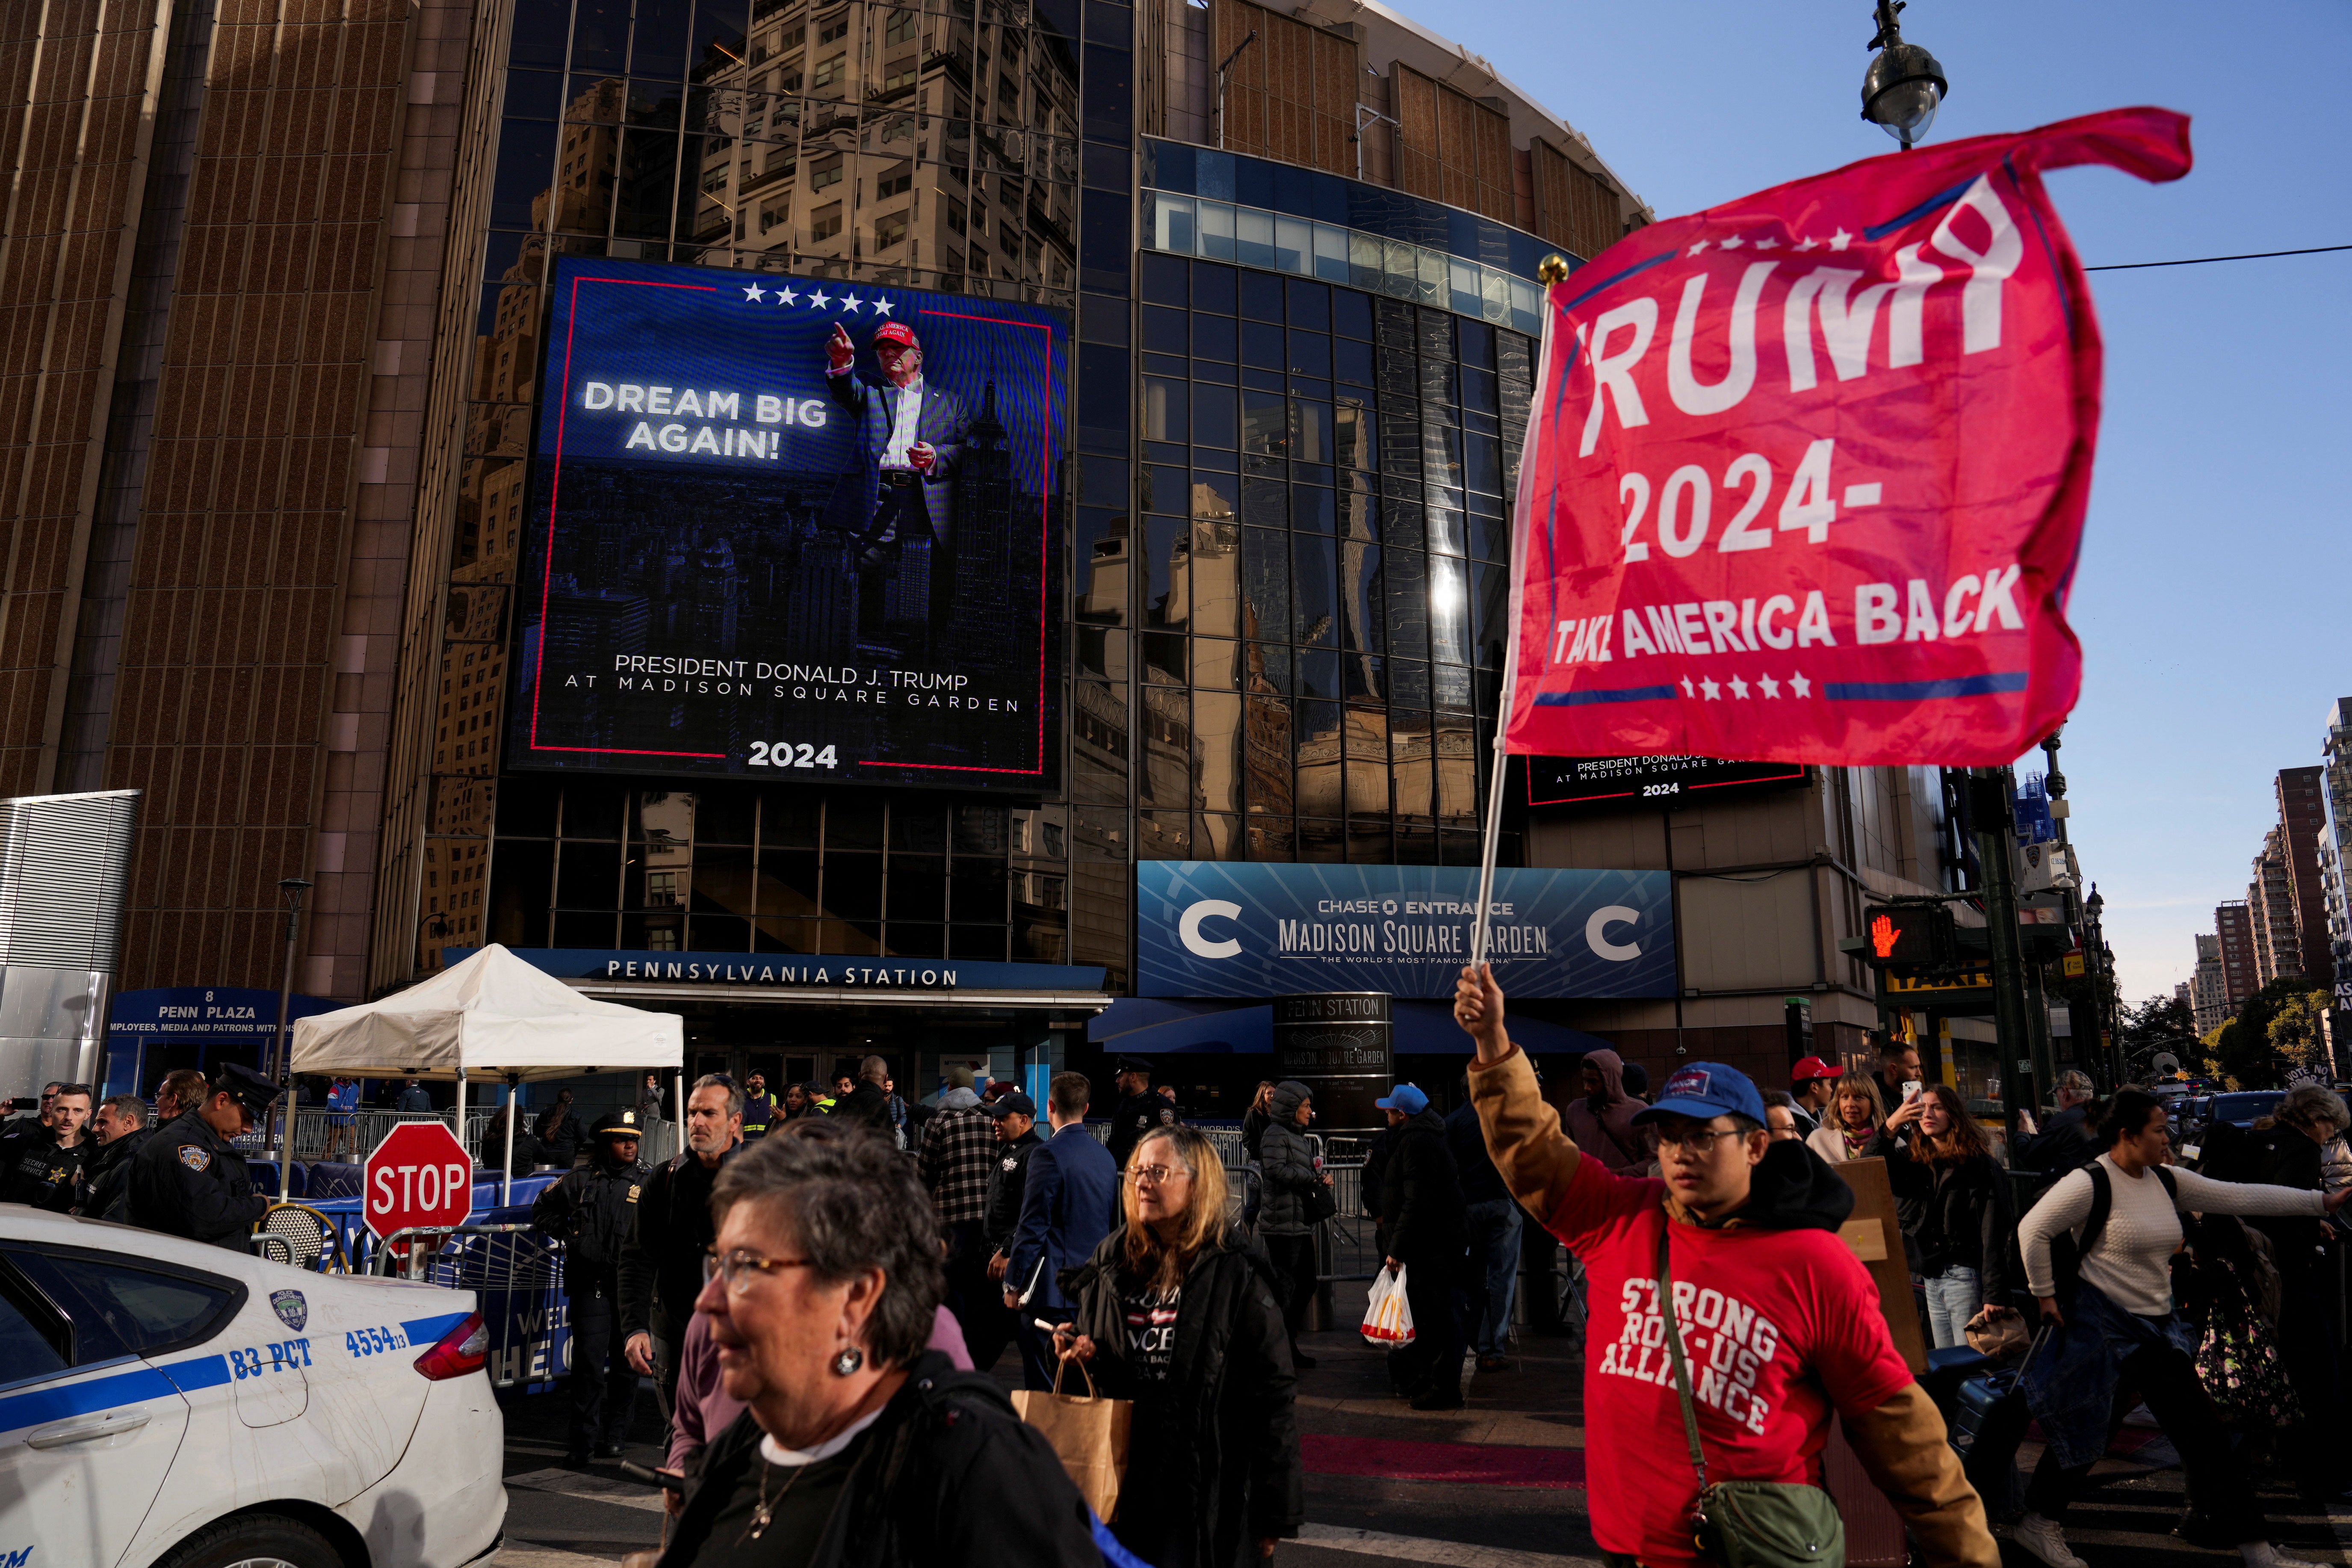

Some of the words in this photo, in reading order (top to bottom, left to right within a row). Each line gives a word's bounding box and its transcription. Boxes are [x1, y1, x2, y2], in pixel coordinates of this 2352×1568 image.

[1576, 172, 2022, 458] RUMP
[885, 324, 908, 332] AMERICA
[584, 381, 740, 420] DREAM
[757, 395, 827, 428] BIG
[625, 422, 780, 460] AGAIN!
[1625, 589, 1837, 659] AMERICA
[1855, 564, 2025, 644] BACK
[615, 655, 748, 678] PRESIDENT
[756, 662, 858, 684] DONALD
[866, 669, 882, 686] J.
[889, 670, 968, 691] TRUMP
[565, 674, 597, 688] AT
[620, 678, 752, 696] MADISON
[774, 685, 887, 704] SQUARE
[908, 694, 1018, 712] GARDEN
[748, 741, 838, 769] 2024
[1577, 757, 1638, 772] PRESIDENT
[1557, 775, 1571, 783] AT
[1580, 767, 1642, 780] MADISON
[1652, 759, 1708, 772] SQUARE
[1643, 783, 1679, 796] 2024
[1318, 900, 1379, 913] CHASE
[1179, 899, 1242, 958] C
[1279, 919, 1375, 952] MADISON
[1384, 920, 1462, 955] SQUARE
[1470, 921, 1547, 954] ARDEN
[1585, 905, 1641, 961] C
[608, 960, 829, 983] PENNSYLVANIA
[845, 967, 956, 986] STATION
[205, 991, 213, 1002] 8
[2340, 997, 2352, 1010] A
[159, 1007, 198, 1018] PENN
[207, 1007, 255, 1018] PLAZA
[1288, 999, 1321, 1017] PENN
[1327, 999, 1378, 1016] STATION
[110, 1023, 158, 1032] MPLOYEES,
[1357, 1049, 1384, 1064] GARDEN
[2285, 1066, 2310, 1081] VOTE
[2314, 1064, 2328, 1075] NO
[2321, 1075, 2328, 1086] 1
[19, 1164, 44, 1176] SERVICE
[24, 1158, 47, 1169] SECRET
[1002, 1158, 1018, 1168] POLICE
[372, 1163, 465, 1214] STOP
[273, 1294, 302, 1305] DEPARTMENT
[275, 1308, 284, 1319] CITY
[1620, 1278, 1779, 1362] STRONG
[229, 1350, 262, 1379] 83
[266, 1338, 312, 1372] PCT
[492, 1340, 550, 1380] HE
[1619, 1312, 1759, 1388] ROK-US
